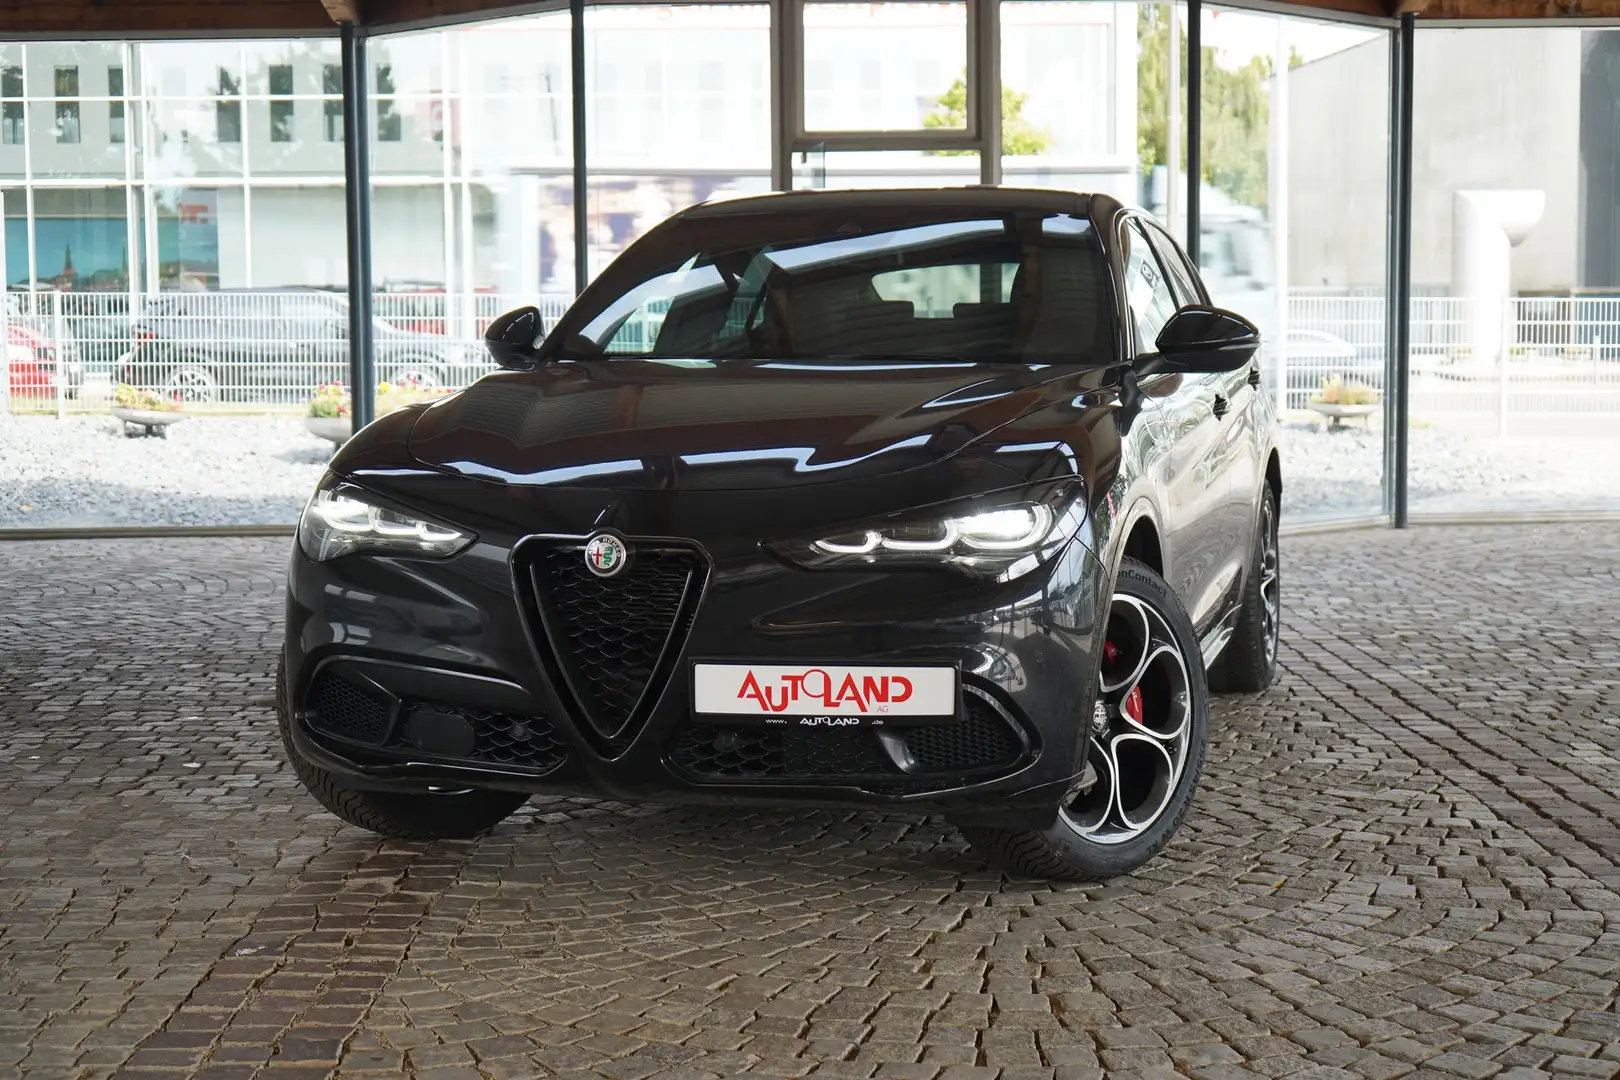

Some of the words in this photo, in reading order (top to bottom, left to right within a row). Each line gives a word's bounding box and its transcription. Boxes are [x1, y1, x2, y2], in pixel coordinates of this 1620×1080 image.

[736, 668, 914, 712] AUTOLAND
[877, 705, 889, 713] AG
[799, 716, 860, 727] AUTOLAND
